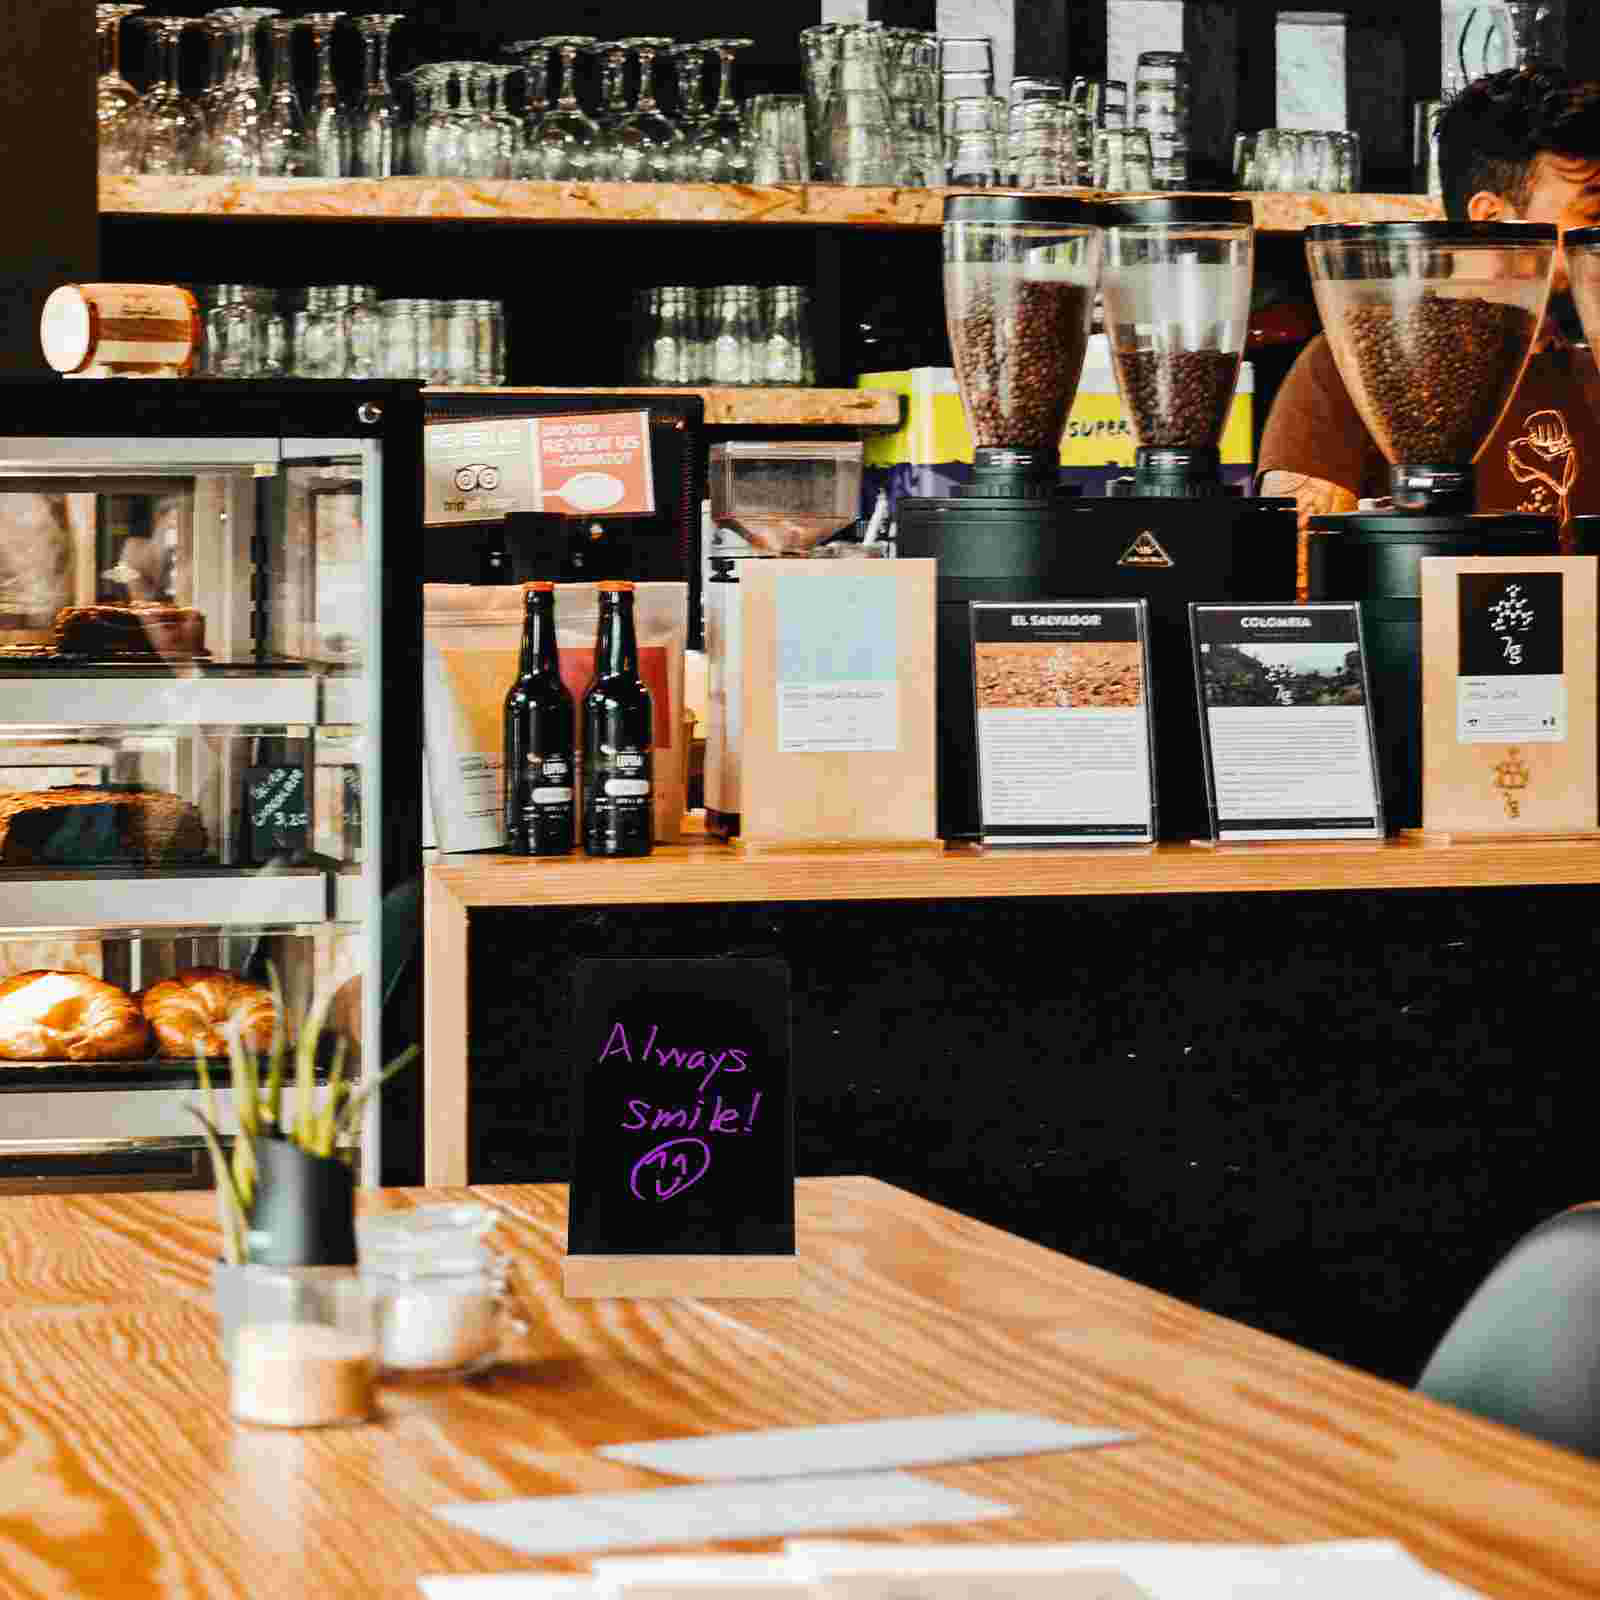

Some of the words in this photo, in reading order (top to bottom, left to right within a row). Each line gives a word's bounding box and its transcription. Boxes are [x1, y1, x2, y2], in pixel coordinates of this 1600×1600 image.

[1011, 615, 1028, 626] EL
[1030, 614, 1102, 626] SALVADOR
[597, 1022, 749, 1091] Always
